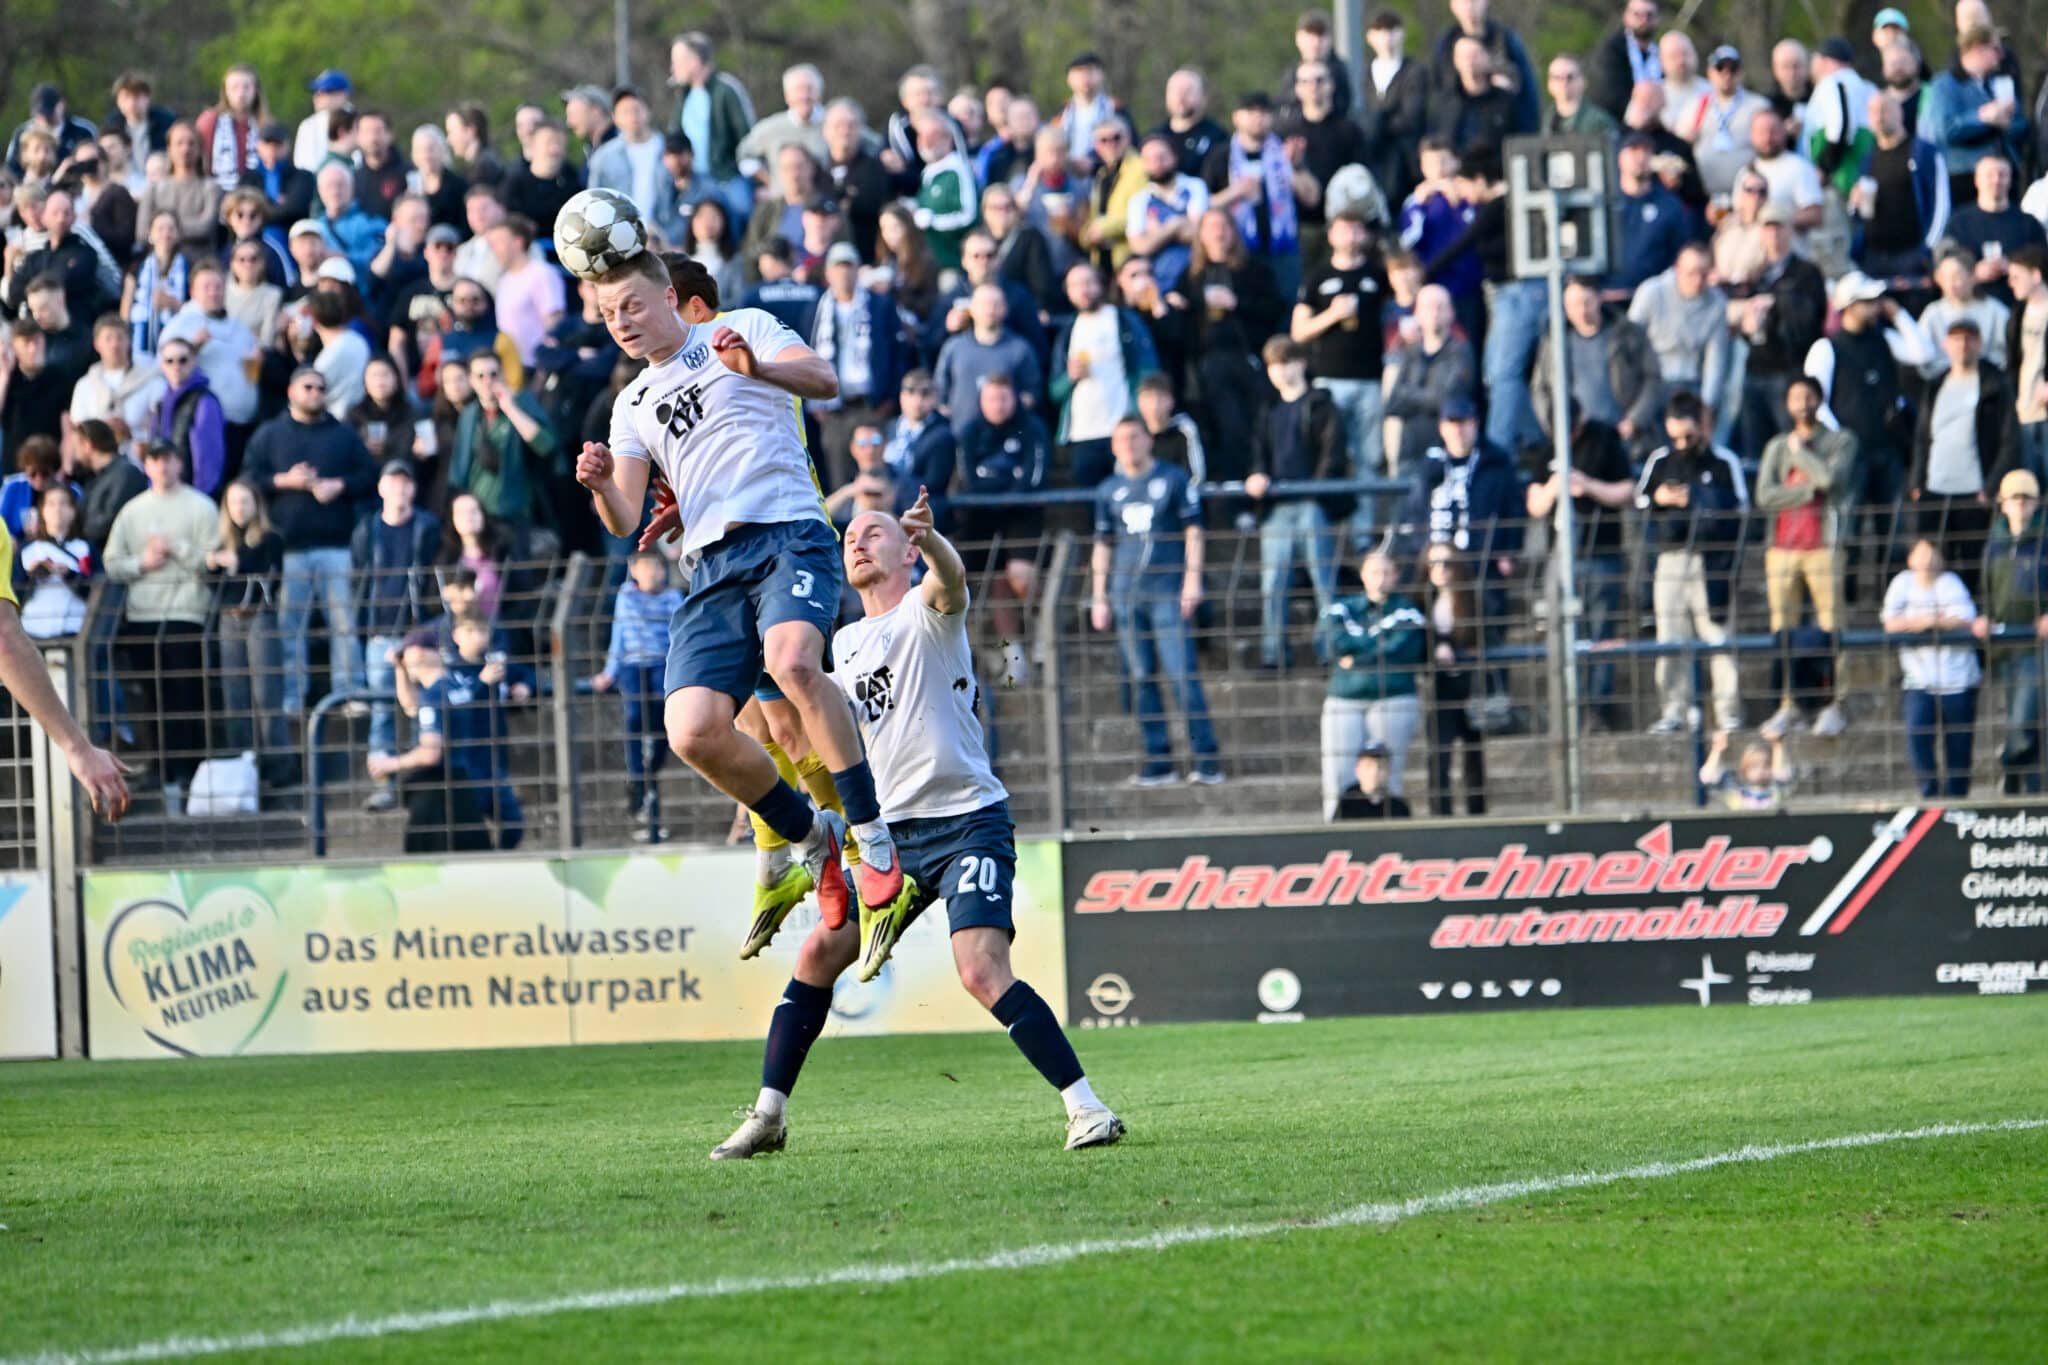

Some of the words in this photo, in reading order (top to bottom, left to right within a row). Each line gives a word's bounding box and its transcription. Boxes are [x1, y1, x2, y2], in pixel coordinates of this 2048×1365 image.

[792, 570, 814, 598] 3
[958, 855, 997, 894] 20
[1075, 822, 1811, 914] schachtschneider
[306, 930, 376, 961] Das
[393, 922, 695, 960] Mineralwasser
[1430, 895, 1789, 949] automobile
[142, 937, 257, 1003] KLIMA
[303, 981, 371, 1013] aus
[386, 976, 471, 1009] dem
[488, 970, 701, 1012] Naturpark
[1420, 978, 1562, 1000] VOLVO
[161, 981, 260, 1027] NEUTRAL
